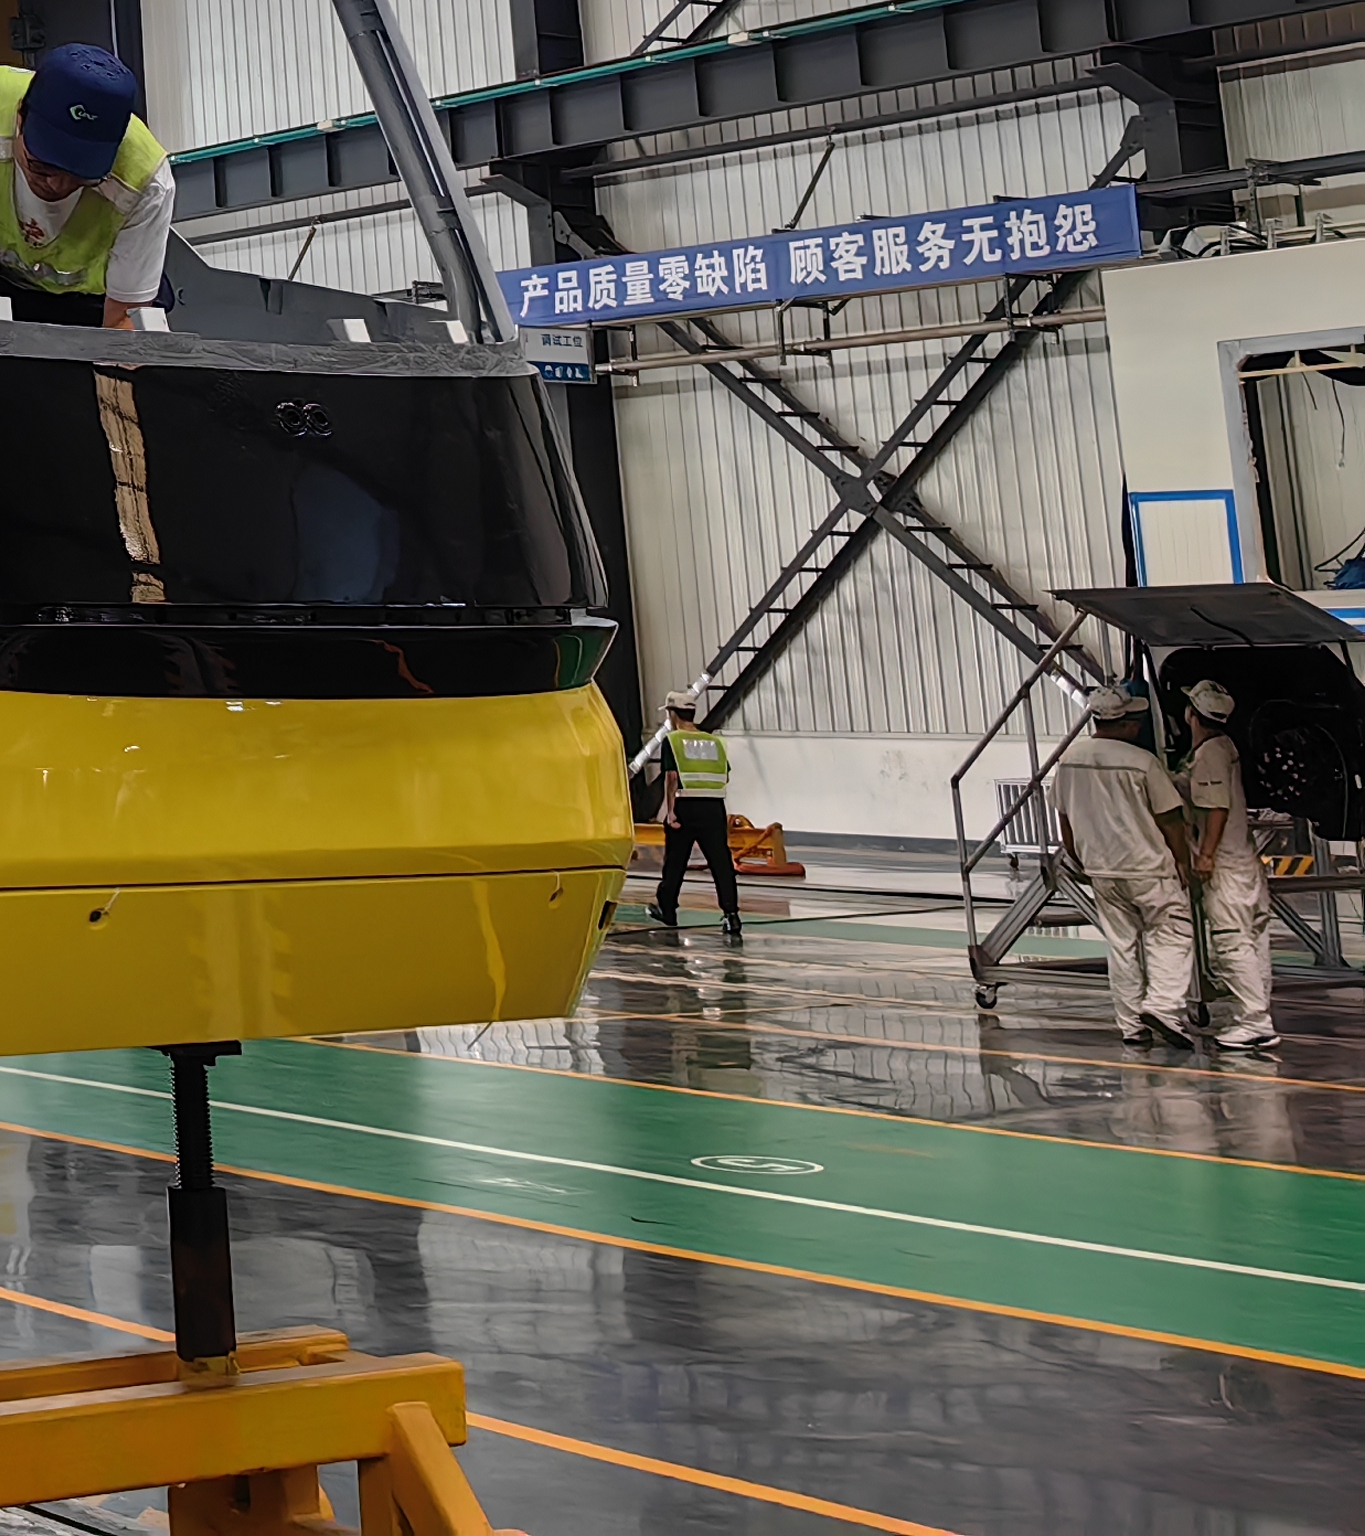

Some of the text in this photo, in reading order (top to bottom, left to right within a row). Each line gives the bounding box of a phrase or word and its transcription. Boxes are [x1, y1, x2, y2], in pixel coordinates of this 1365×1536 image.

[519, 202, 1098, 318] 产品质量零缺陷 顾客服务无抱怨
[541, 333, 583, 348] 调试工位
